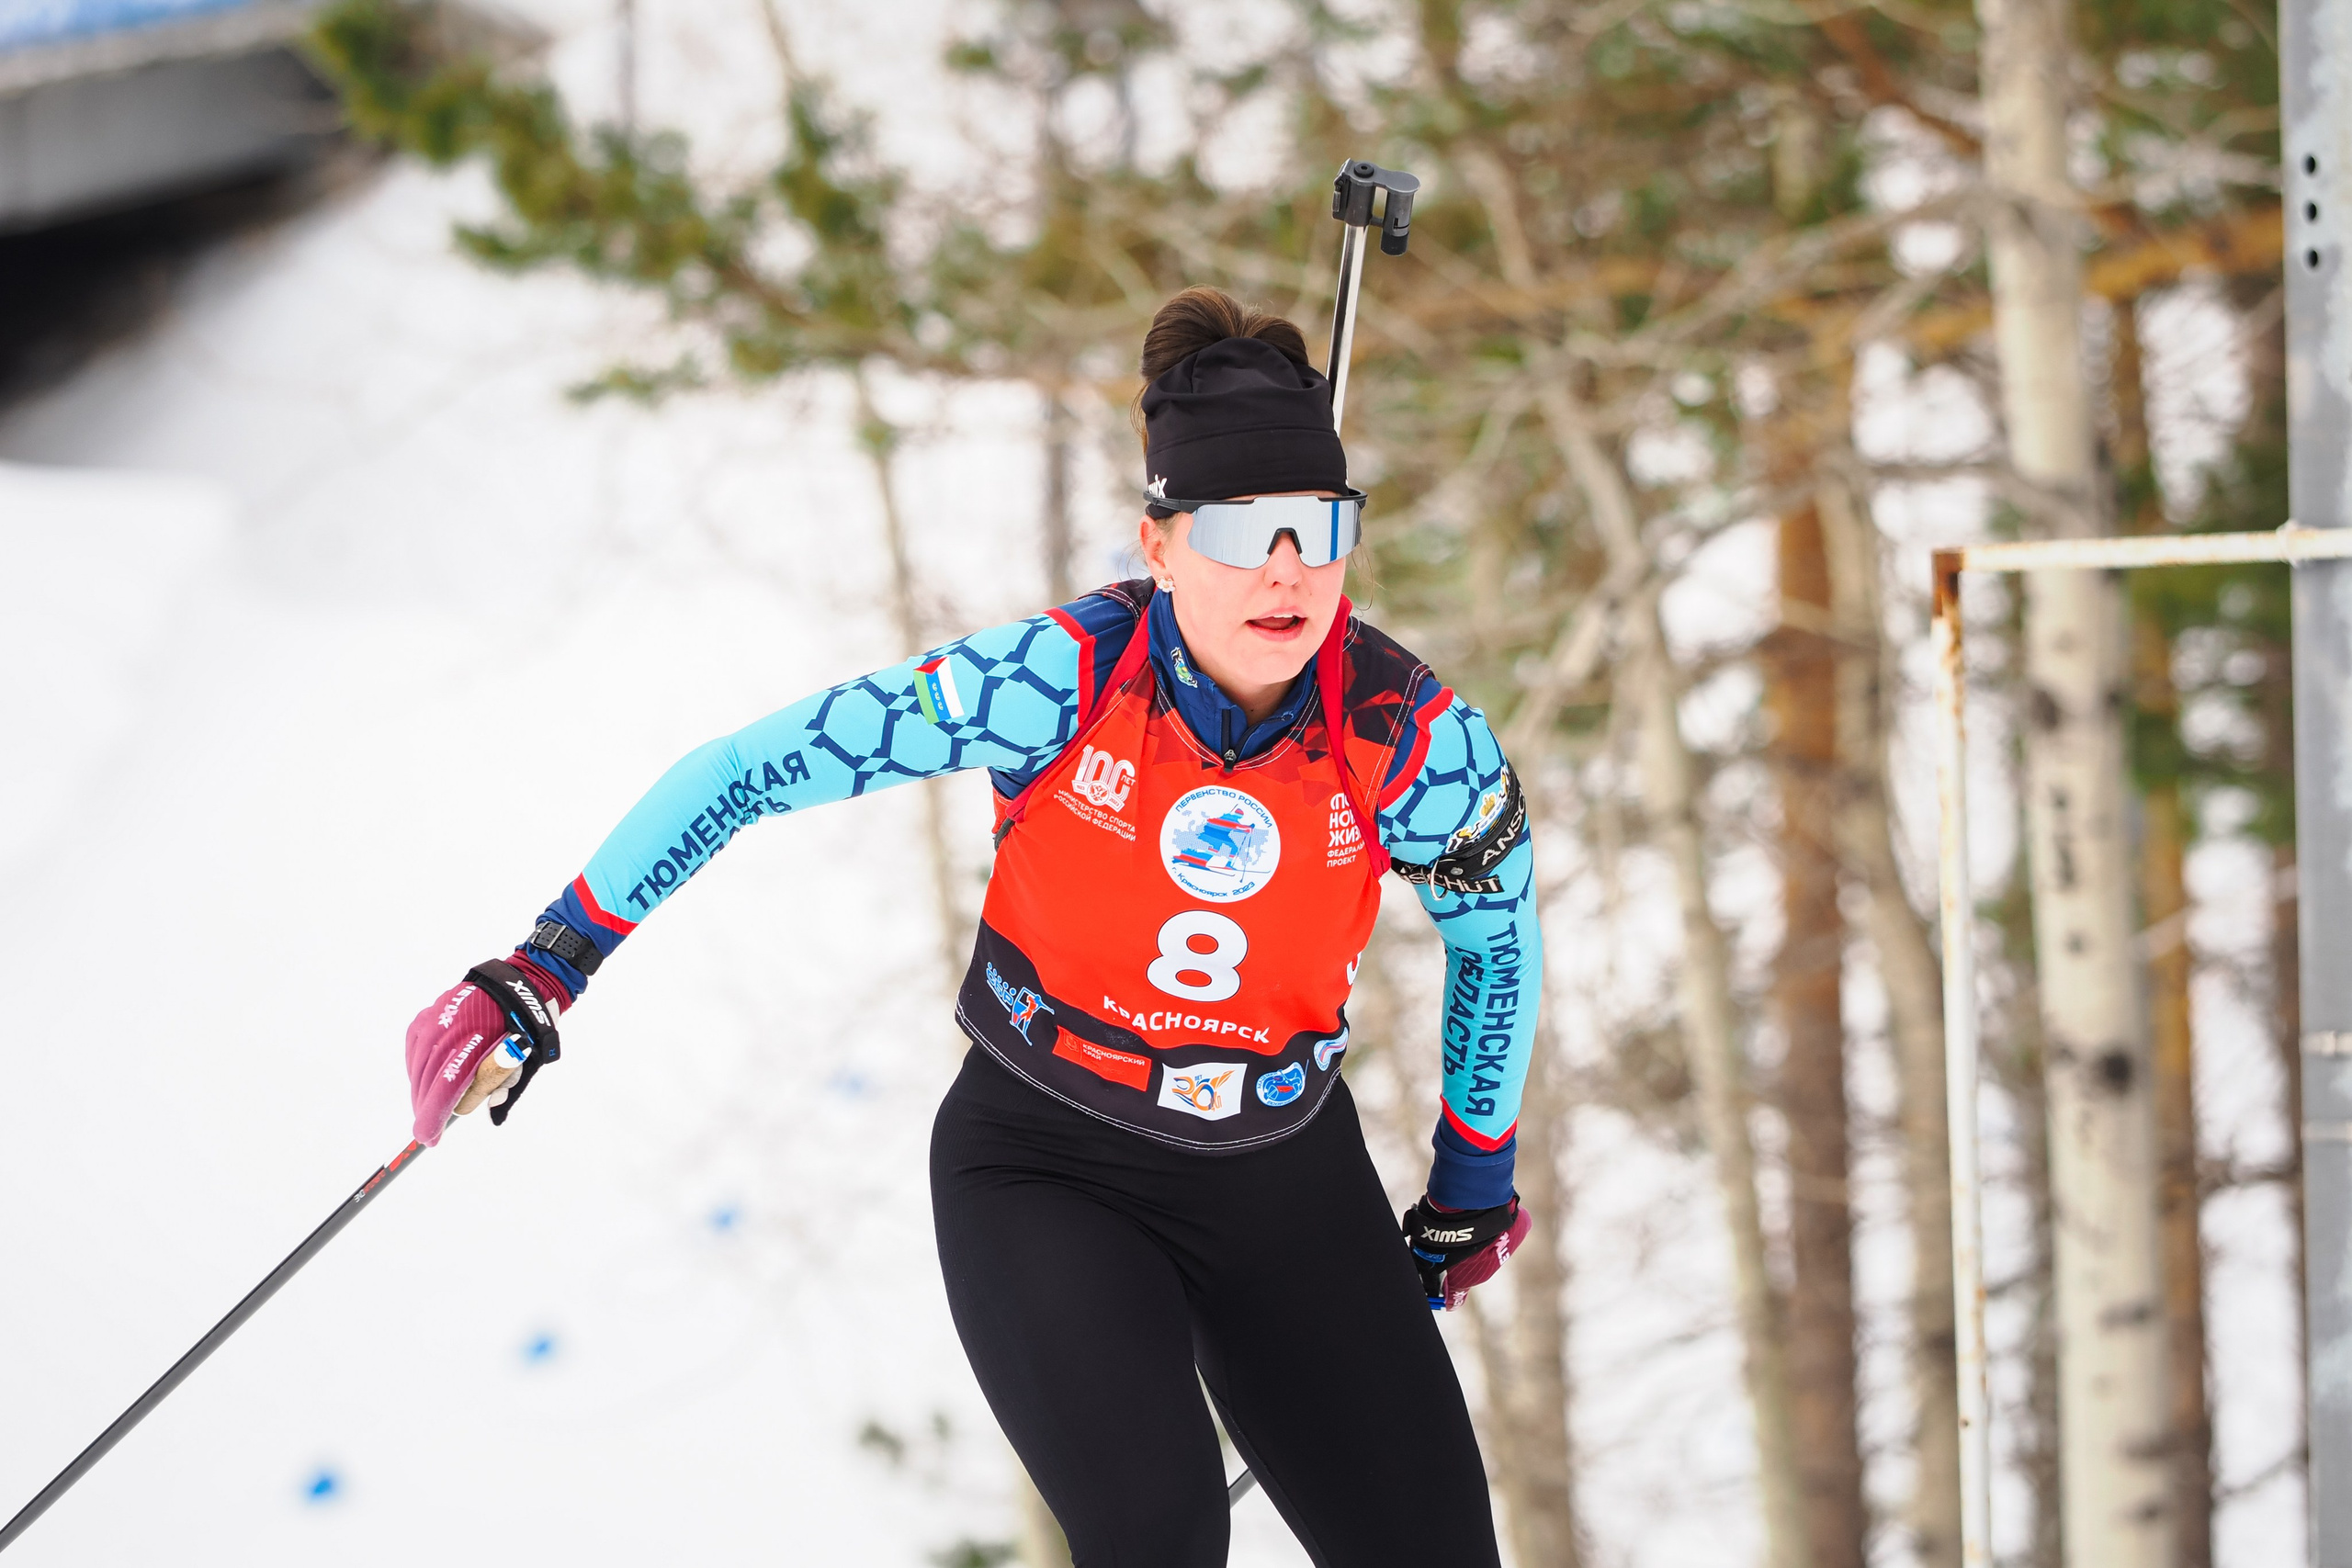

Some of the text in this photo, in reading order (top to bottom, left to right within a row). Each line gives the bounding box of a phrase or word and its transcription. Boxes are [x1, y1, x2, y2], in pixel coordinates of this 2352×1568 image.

[1121, 774, 1136, 786] ЛЕТ
[626, 750, 811, 911] ТЮМЕНСКАЯ
[1053, 794, 1136, 842] РОССИЙСКОЙ ФЕДЕРАЦИИ
[1057, 789, 1136, 833] МИНИСТЕРСТВО СПОРТА
[1175, 788, 1273, 829] ПЕРВЕНСТВО РОССИИ
[1482, 786, 1526, 866] ANSC
[1326, 854, 1357, 868] ПРОЕКТ
[1327, 840, 1366, 858] ФЕДЕРАЛЬ
[1177, 872, 1228, 897] Красноярск
[1231, 881, 1256, 896] 2023
[1146, 909, 1249, 1002] 8
[1102, 995, 1270, 1044] КРАСНОЯРСК
[1464, 919, 1522, 1117] ТЮМЕНСКАЯ
[442, 1033, 484, 1083] KINETIXX
[1082, 1043, 1146, 1066] КРАСНОЯРСКИЙ
[1082, 1049, 1102, 1061] КРАЙ
